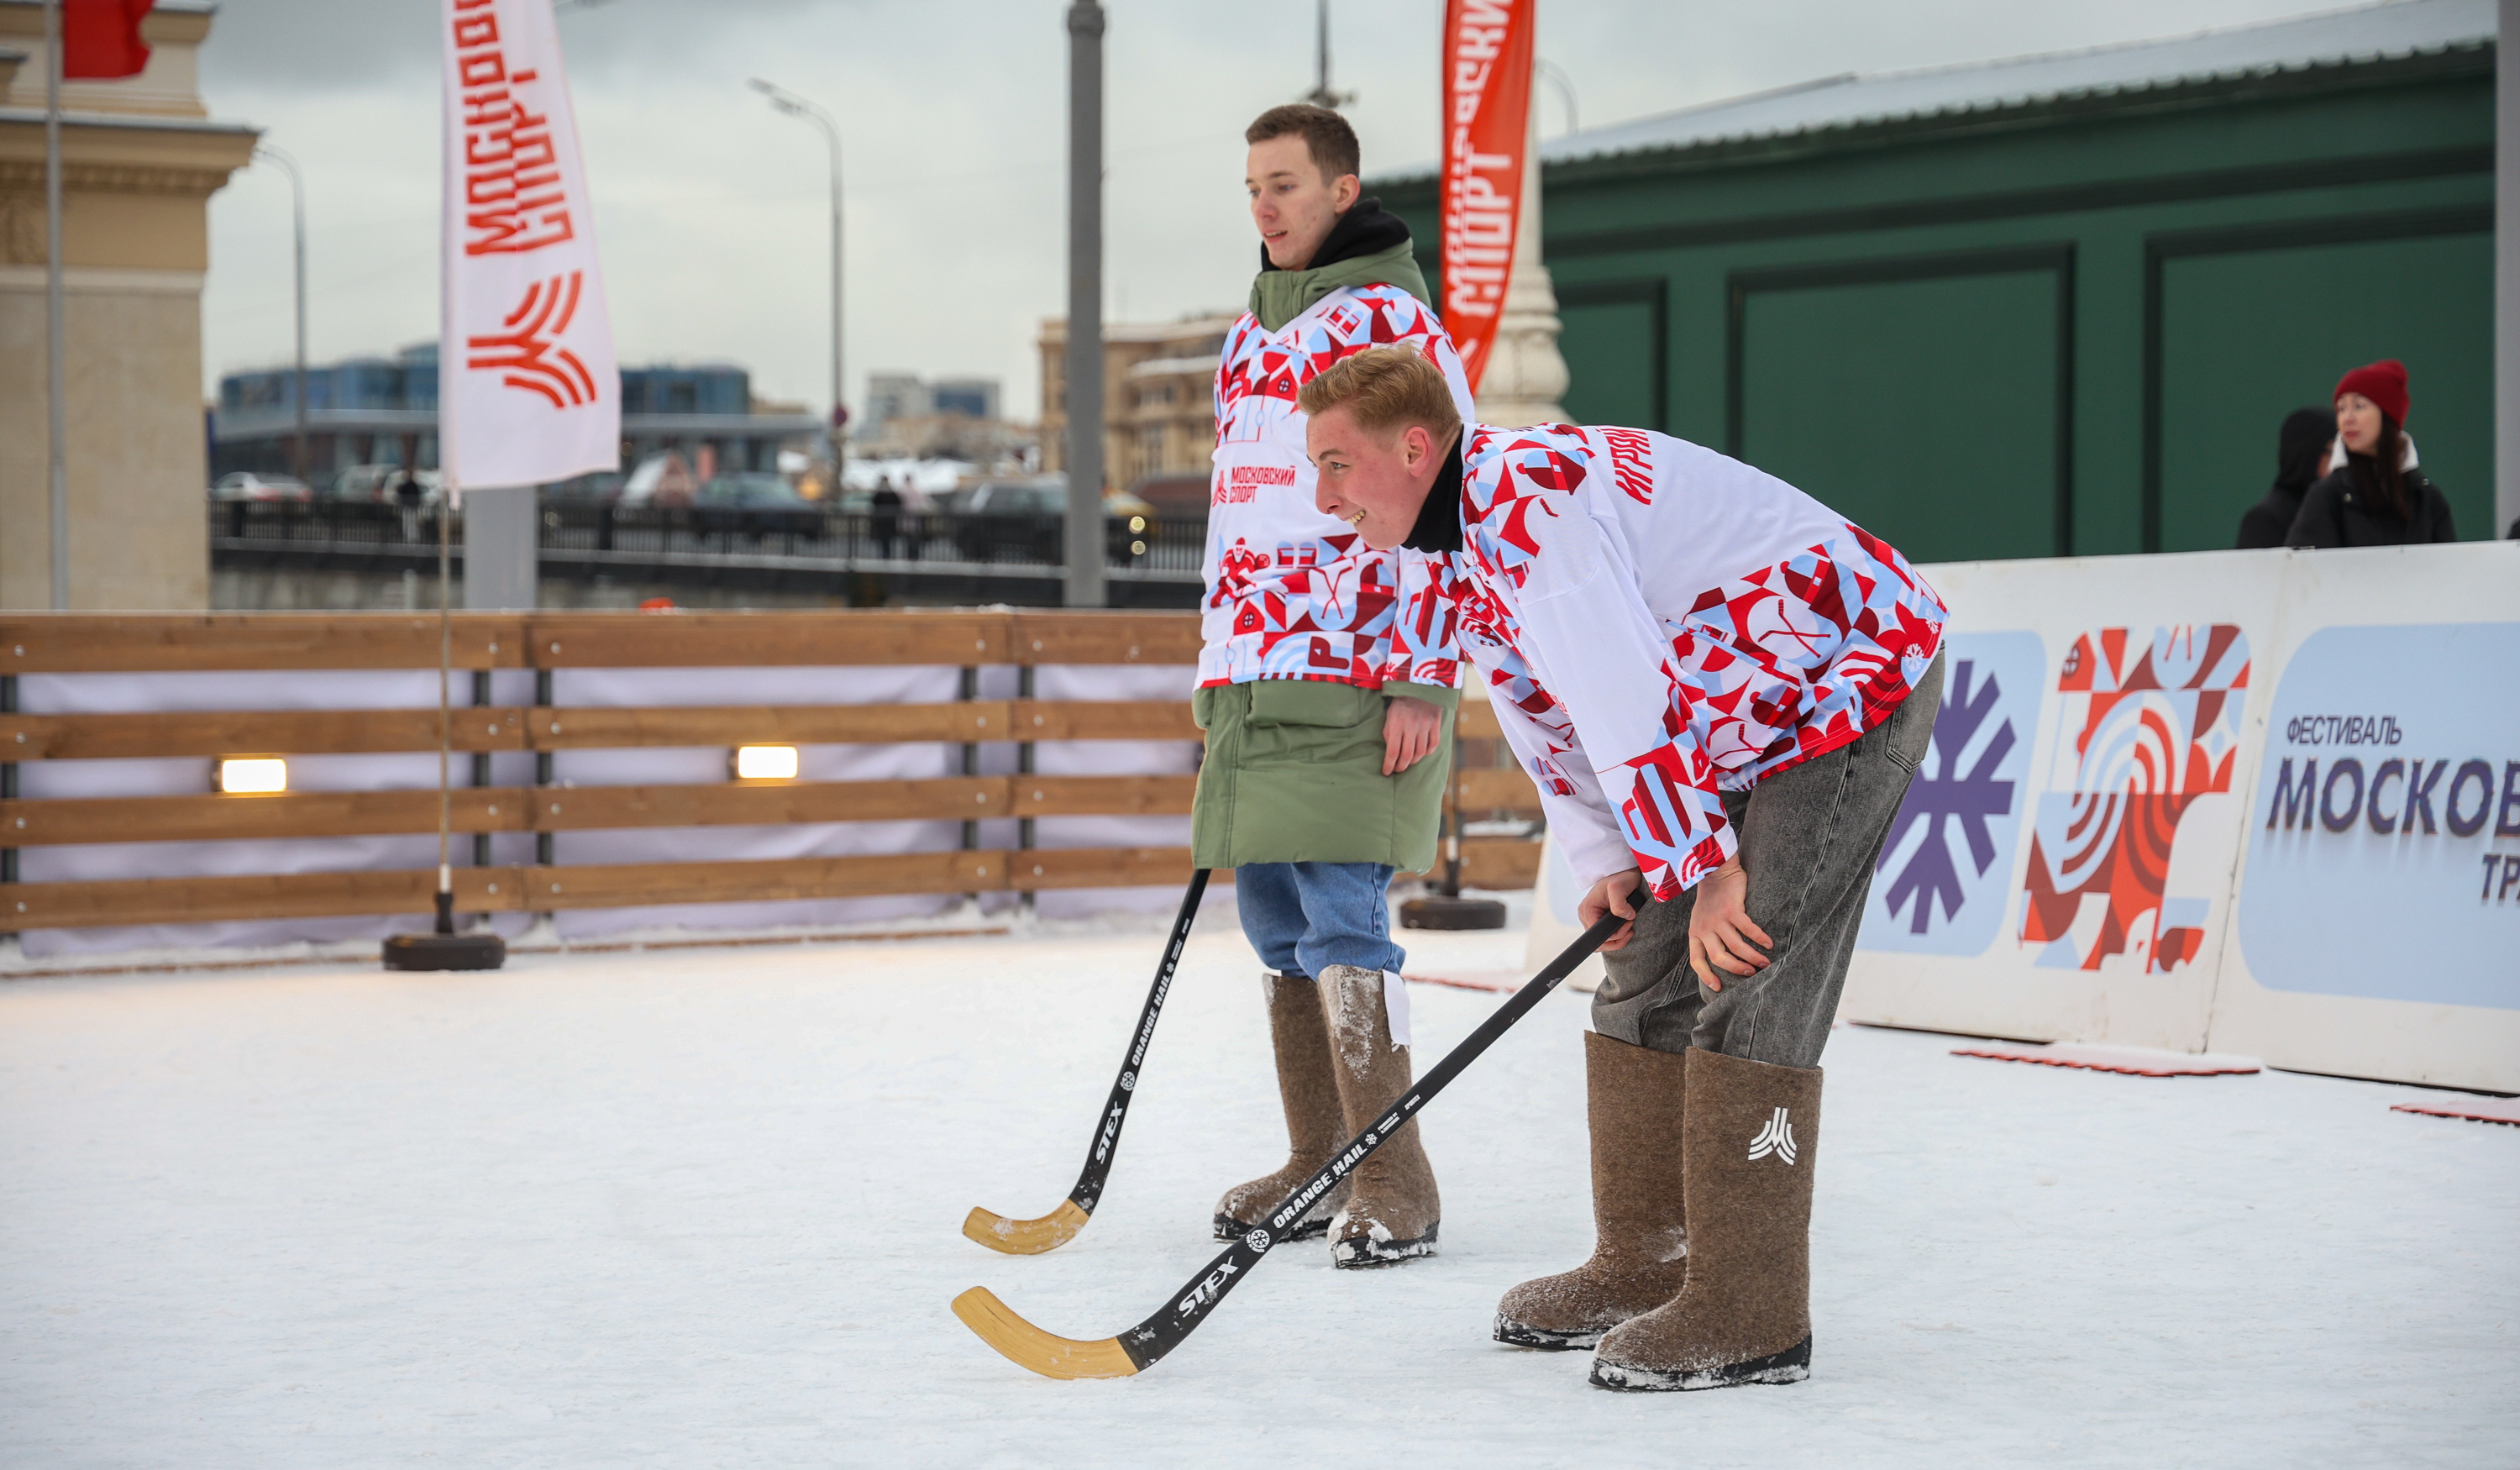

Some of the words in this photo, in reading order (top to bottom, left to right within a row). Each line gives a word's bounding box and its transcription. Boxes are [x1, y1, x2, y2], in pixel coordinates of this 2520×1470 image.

[1229, 486, 1257, 503] СПОРТ
[1231, 465, 1295, 486] МОСКОВСКИЙ
[2286, 716, 2402, 746] ФЕСТИВАЛЬ
[2481, 853, 2520, 900] ТР
[1131, 1006, 1158, 1066] ORANGE
[1153, 974, 1171, 1007] HAIL
[1095, 1101, 1123, 1164] STEX
[1273, 1172, 1333, 1229] ORANGE
[1331, 1143, 1368, 1176] HAIL
[1179, 1255, 1238, 1318] STEX
